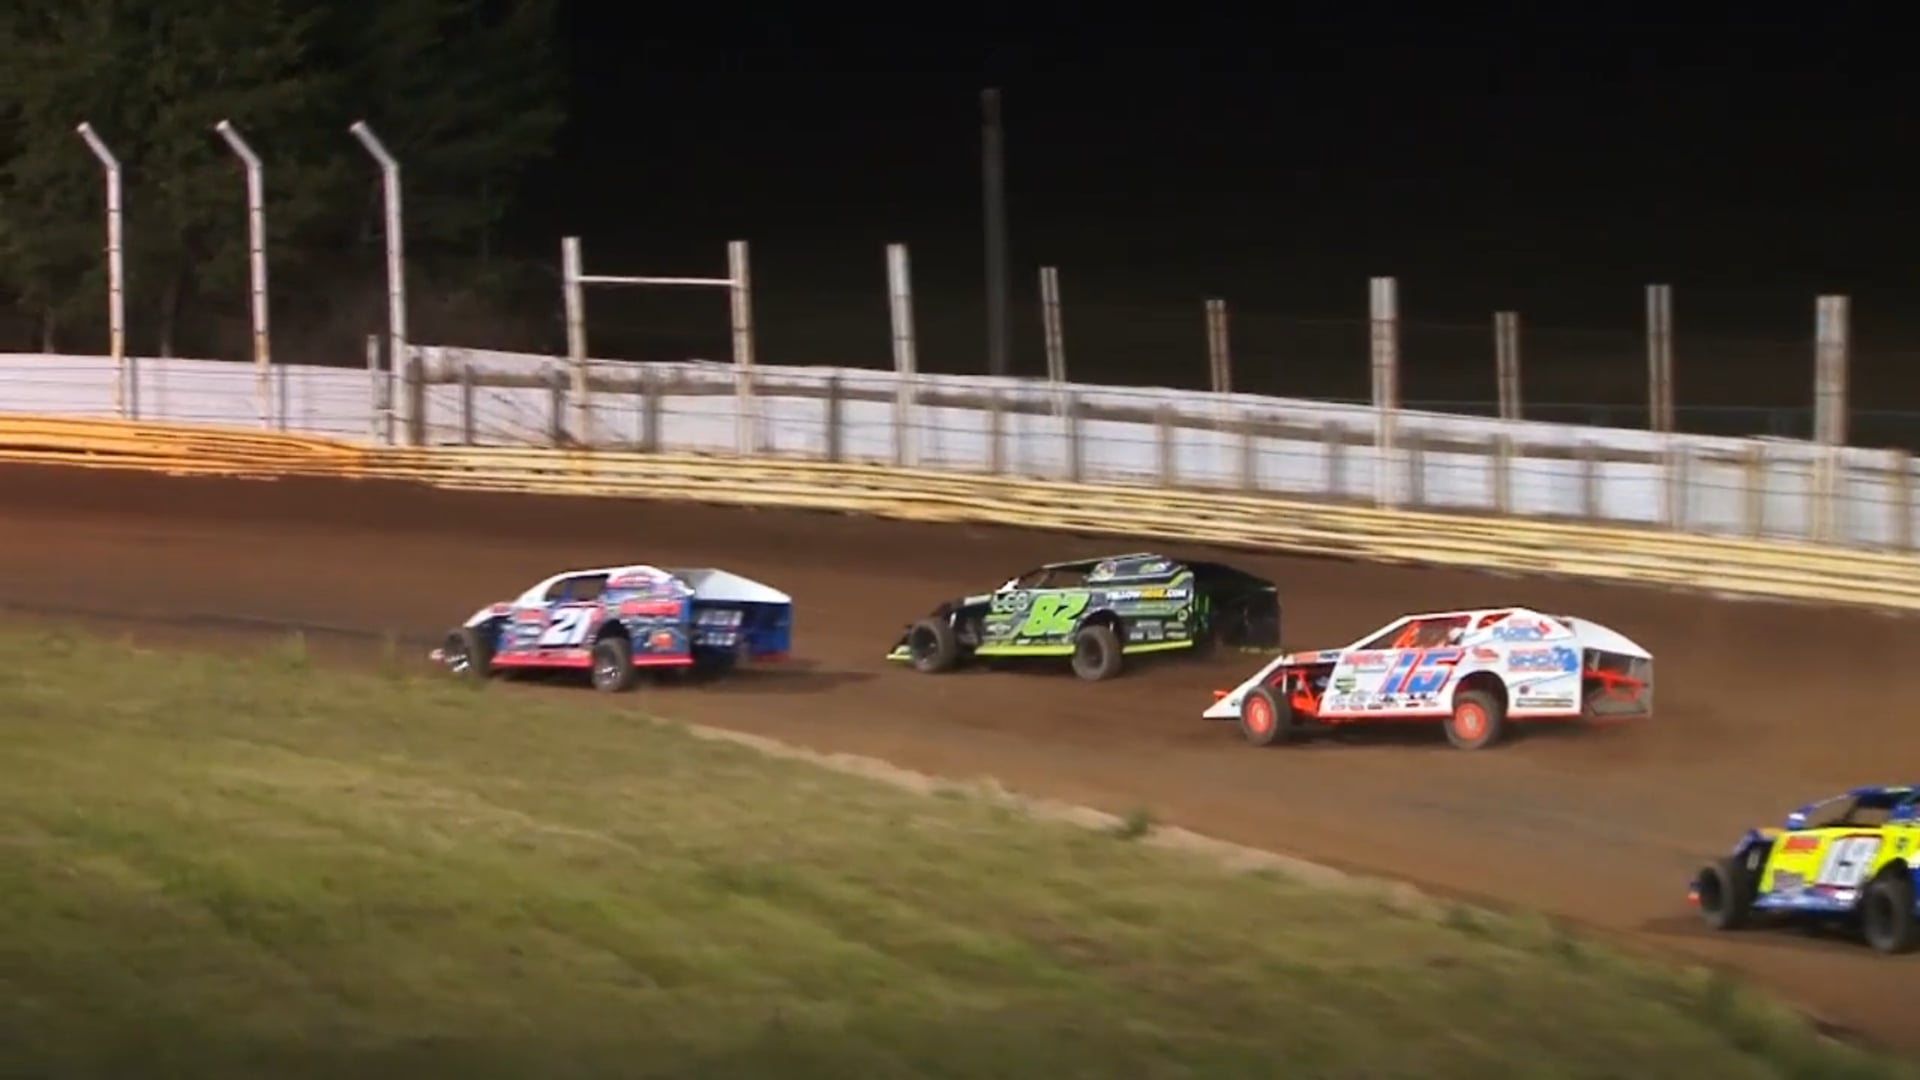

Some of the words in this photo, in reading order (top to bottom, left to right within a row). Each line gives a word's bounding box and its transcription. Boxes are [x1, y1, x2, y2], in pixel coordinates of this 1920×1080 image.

[539, 607, 593, 645] 21
[1022, 592, 1091, 636] 82
[1382, 650, 1464, 694] 15
